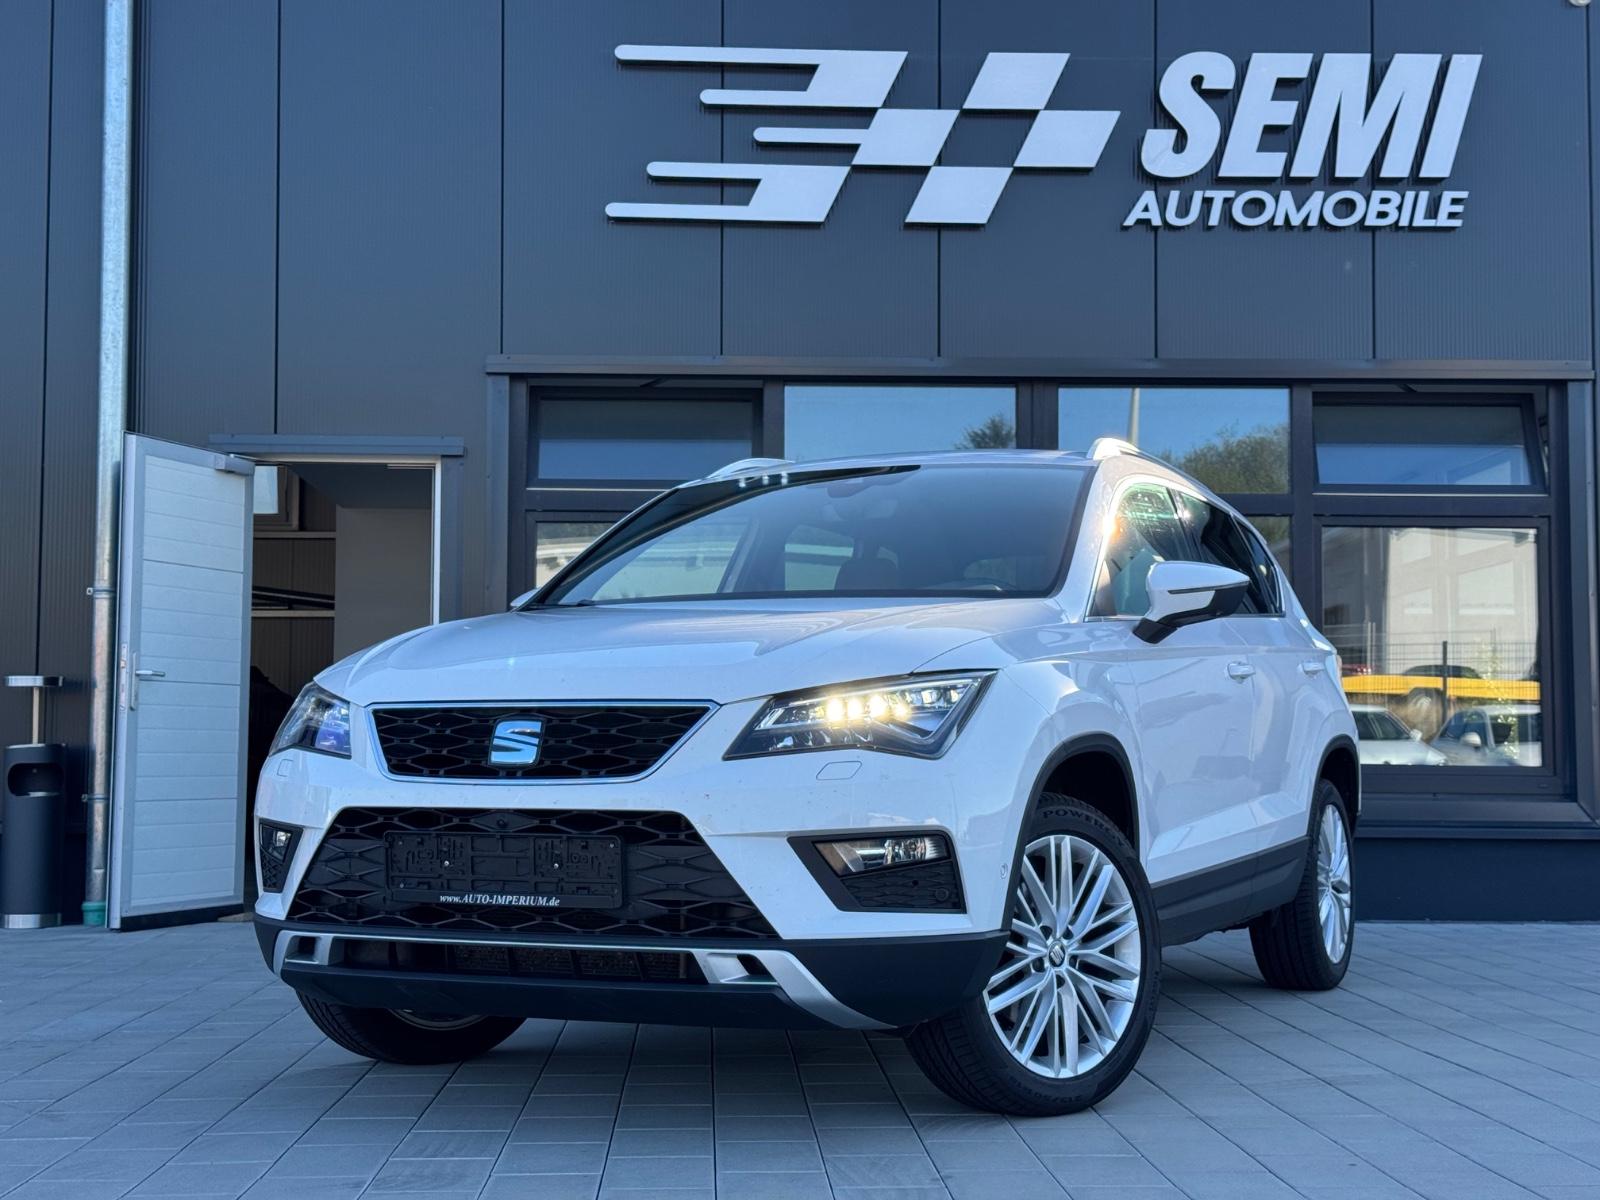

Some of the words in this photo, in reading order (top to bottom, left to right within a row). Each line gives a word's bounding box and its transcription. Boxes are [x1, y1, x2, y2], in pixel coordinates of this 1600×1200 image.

[1141, 51, 1483, 178] SEMI
[1122, 190, 1470, 227] AUTOMOBILE
[439, 894, 561, 906] www.AUTO-IMPERIUM.de
